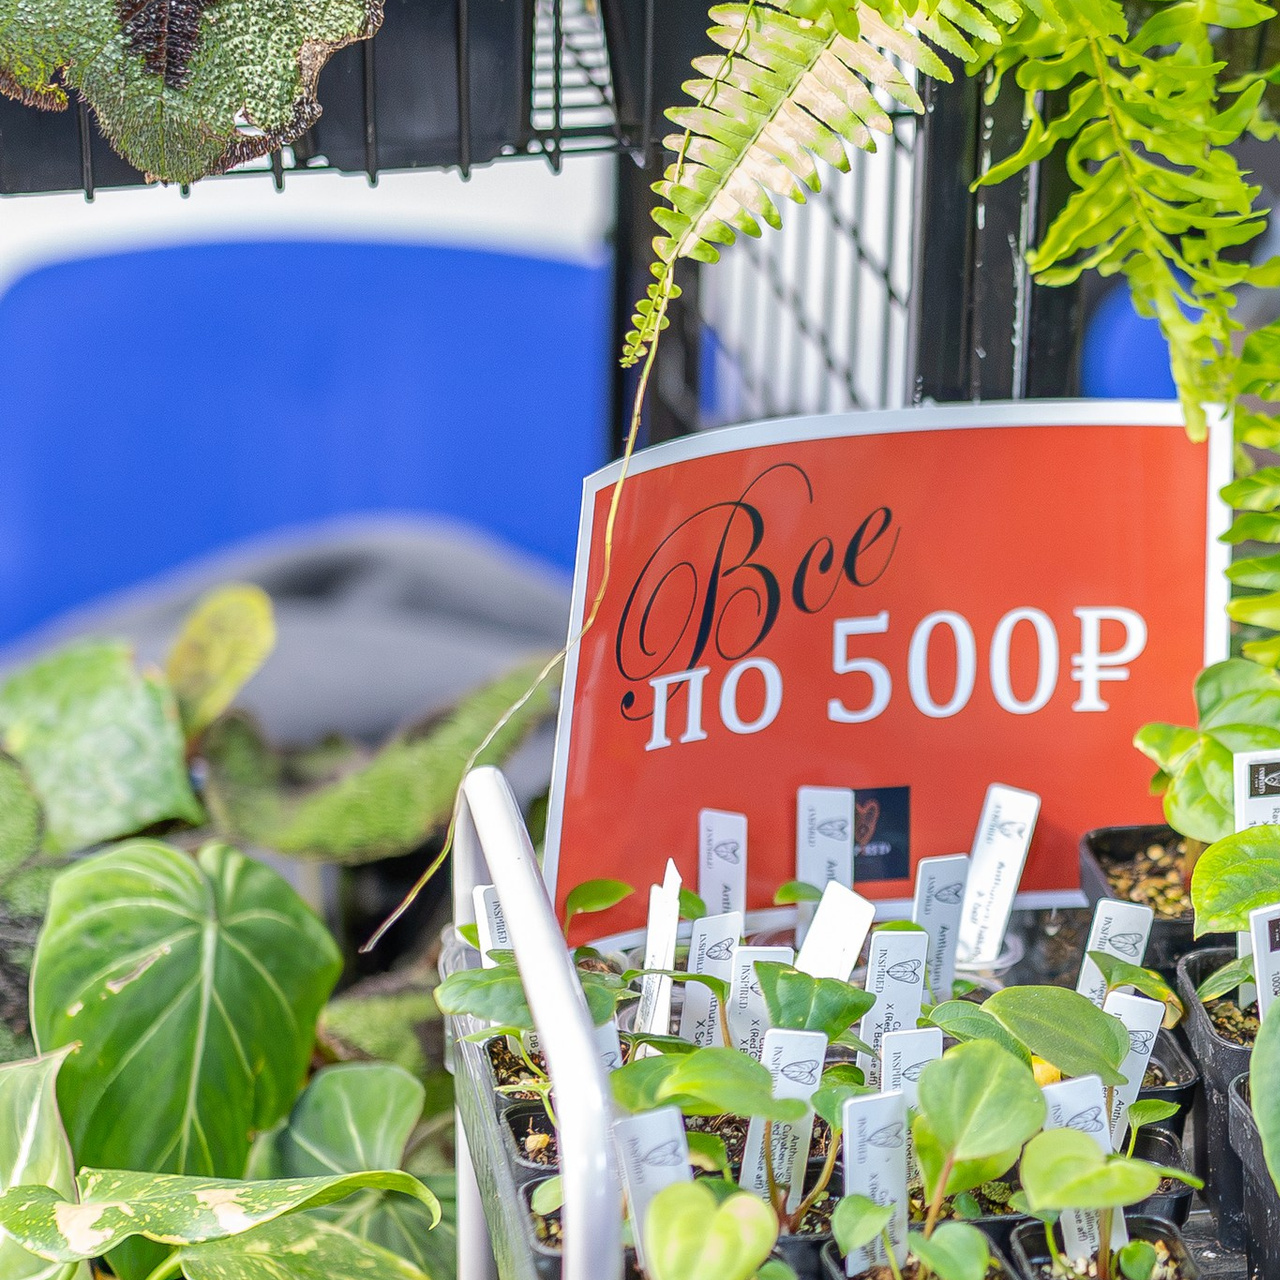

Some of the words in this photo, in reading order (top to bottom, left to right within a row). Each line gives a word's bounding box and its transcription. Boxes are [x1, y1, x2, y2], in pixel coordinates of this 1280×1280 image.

[616, 463, 901, 720] Все
[646, 657, 783, 751] по
[827, 606, 1148, 723] 500₽
[493, 900, 507, 944] INSPIRED
[875, 948, 888, 994] INSPIRED
[932, 925, 950, 985] Anthurium
[738, 964, 752, 1009] INSPIRED
[695, 1020, 706, 1030] X
[705, 992, 719, 1046] nthurium
[749, 1028, 761, 1049] (Red
[529, 1035, 539, 1049] DB
[891, 1051, 902, 1090] INSPIRE
[784, 1134, 800, 1184] Anthurium
